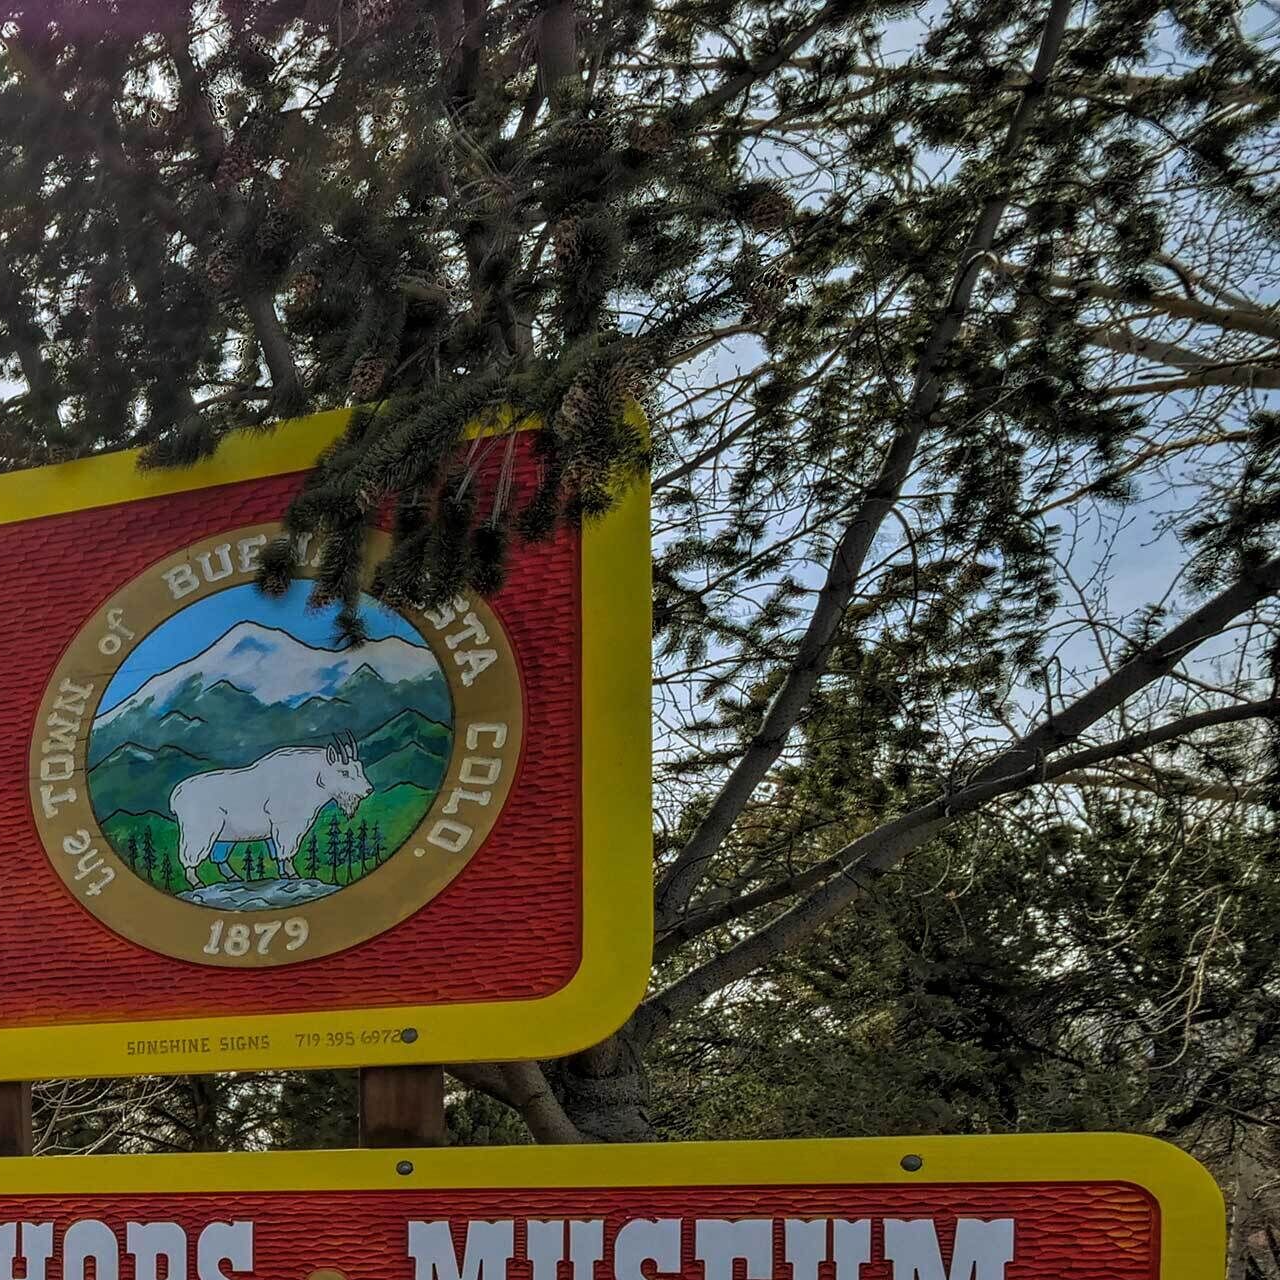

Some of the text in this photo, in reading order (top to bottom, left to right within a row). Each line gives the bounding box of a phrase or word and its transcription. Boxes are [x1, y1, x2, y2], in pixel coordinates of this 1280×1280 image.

[98, 608, 135, 655] of
[39, 678, 94, 818] TOWN
[62, 829, 117, 897] the
[203, 917, 309, 957] 1879
[219, 1035, 271, 1051] SIGNS
[295, 1032, 321, 1048] 719
[326, 1031, 356, 1047] 395
[360, 1029, 402, 1045] 6972
